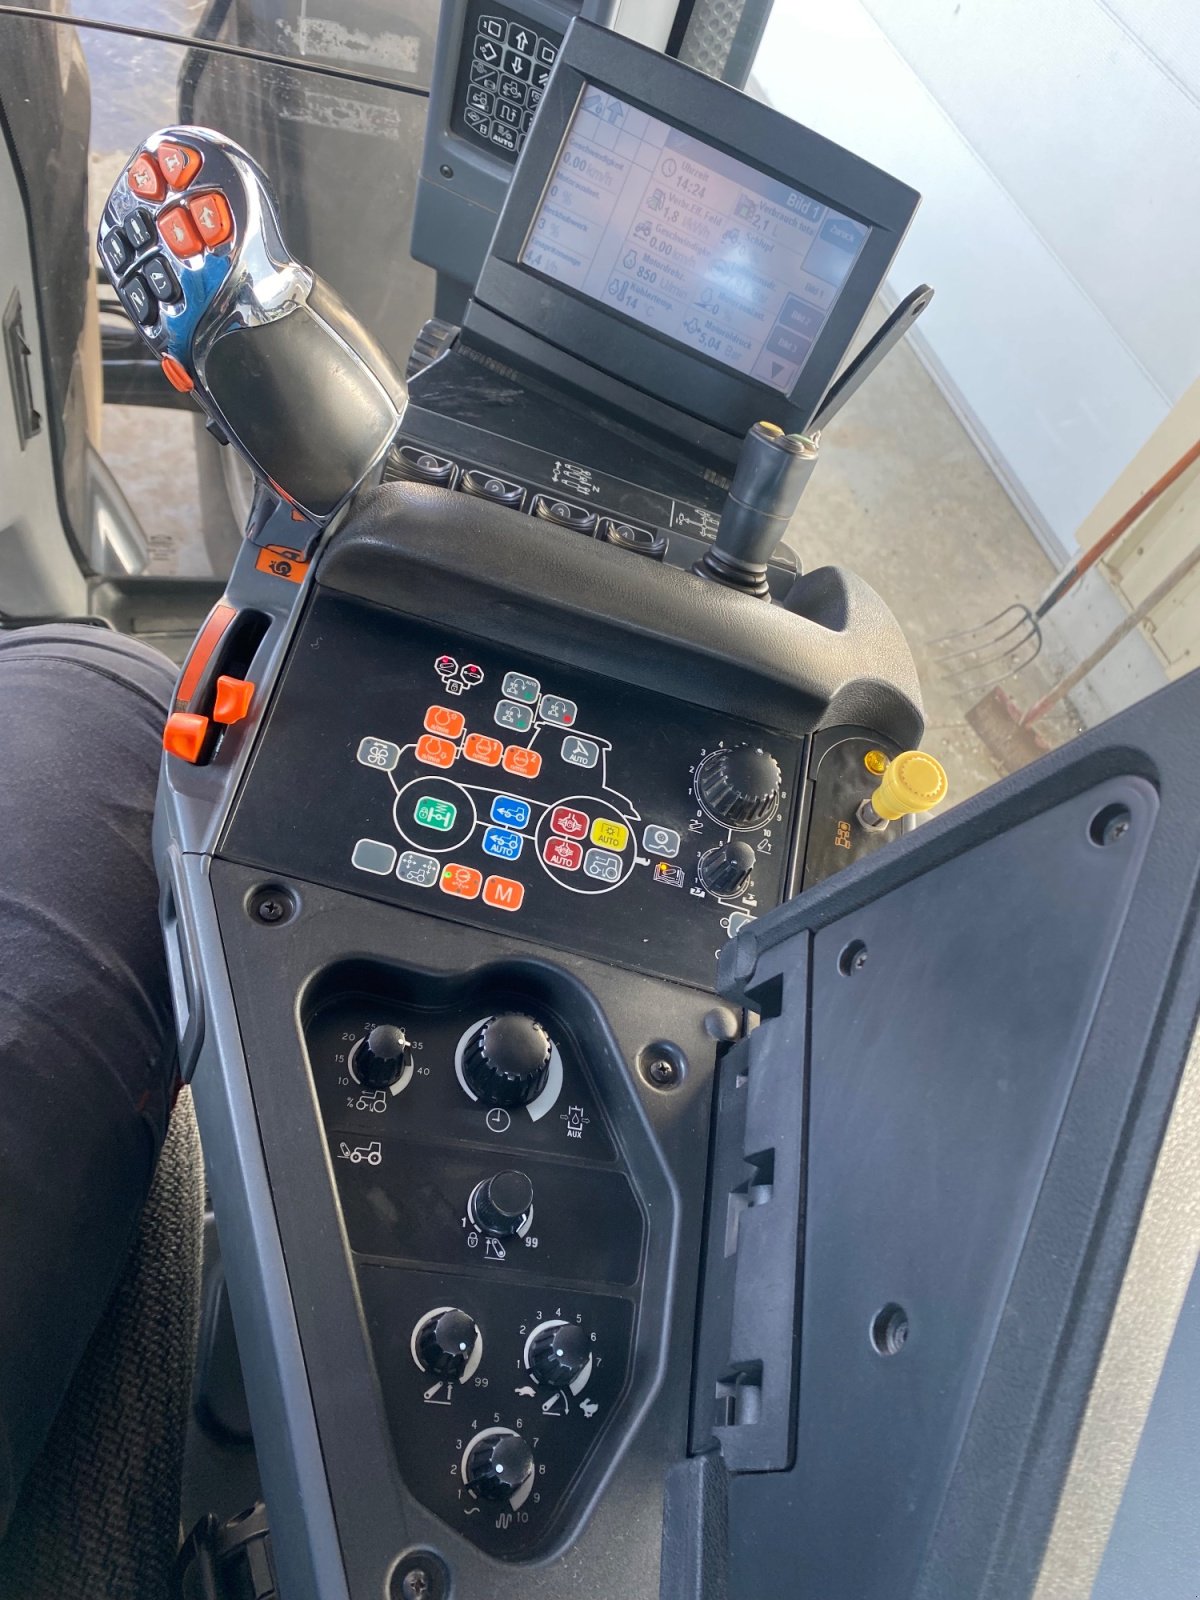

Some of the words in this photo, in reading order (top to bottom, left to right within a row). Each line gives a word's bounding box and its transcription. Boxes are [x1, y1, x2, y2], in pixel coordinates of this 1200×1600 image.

[493, 135, 513, 148] AUTO
[562, 152, 588, 172] 0.00
[682, 162, 710, 182] Uhrzeit
[550, 186, 559, 197] 0
[676, 176, 707, 199] 14:24
[786, 193, 811, 215] Bild
[812, 207, 820, 219] 1
[663, 207, 680, 223] 1,8
[704, 212, 723, 226] Feld
[759, 201, 800, 228] Verbrauch
[537, 218, 547, 230] 3
[752, 215, 770, 233] 2,1
[649, 237, 673, 256] 0.00
[525, 250, 543, 266] 4,4
[636, 266, 658, 284] 850
[625, 296, 639, 308] 14
[711, 304, 720, 316] 0
[699, 332, 722, 352] 5,04
[525, 680, 537, 688] AUTO
[492, 742, 499, 750] 1
[531, 754, 538, 763] 2
[569, 753, 588, 765] AUTO
[598, 835, 619, 847] AUTO
[490, 844, 514, 856] AUTO
[550, 855, 573, 867] AUTO
[494, 884, 513, 903] M
[364, 1023, 376, 1031] 25
[342, 1033, 356, 1041] 20
[412, 1041, 424, 1050] 35
[335, 1054, 345, 1063] 15
[417, 1067, 430, 1075] 40
[338, 1077, 349, 1085] 10
[346, 1096, 354, 1107] %
[567, 1130, 582, 1139] AUX
[461, 1217, 466, 1228] 1
[525, 1237, 538, 1248] 99
[536, 1311, 542, 1320] 3
[555, 1308, 561, 1317] 4
[576, 1314, 582, 1323] 5
[519, 1325, 526, 1335] 2
[590, 1332, 597, 1341] 6
[516, 1360, 520, 1369] 1
[596, 1358, 602, 1367] 7
[474, 1378, 489, 1388] 99
[494, 1413, 500, 1422] 5
[472, 1420, 478, 1429] 4
[516, 1418, 523, 1428] 6
[456, 1440, 462, 1449] 3
[533, 1438, 539, 1447] 7
[450, 1465, 457, 1475] 2
[539, 1465, 546, 1475] 8
[534, 1493, 541, 1502] 9
[516, 1513, 529, 1523] 10
